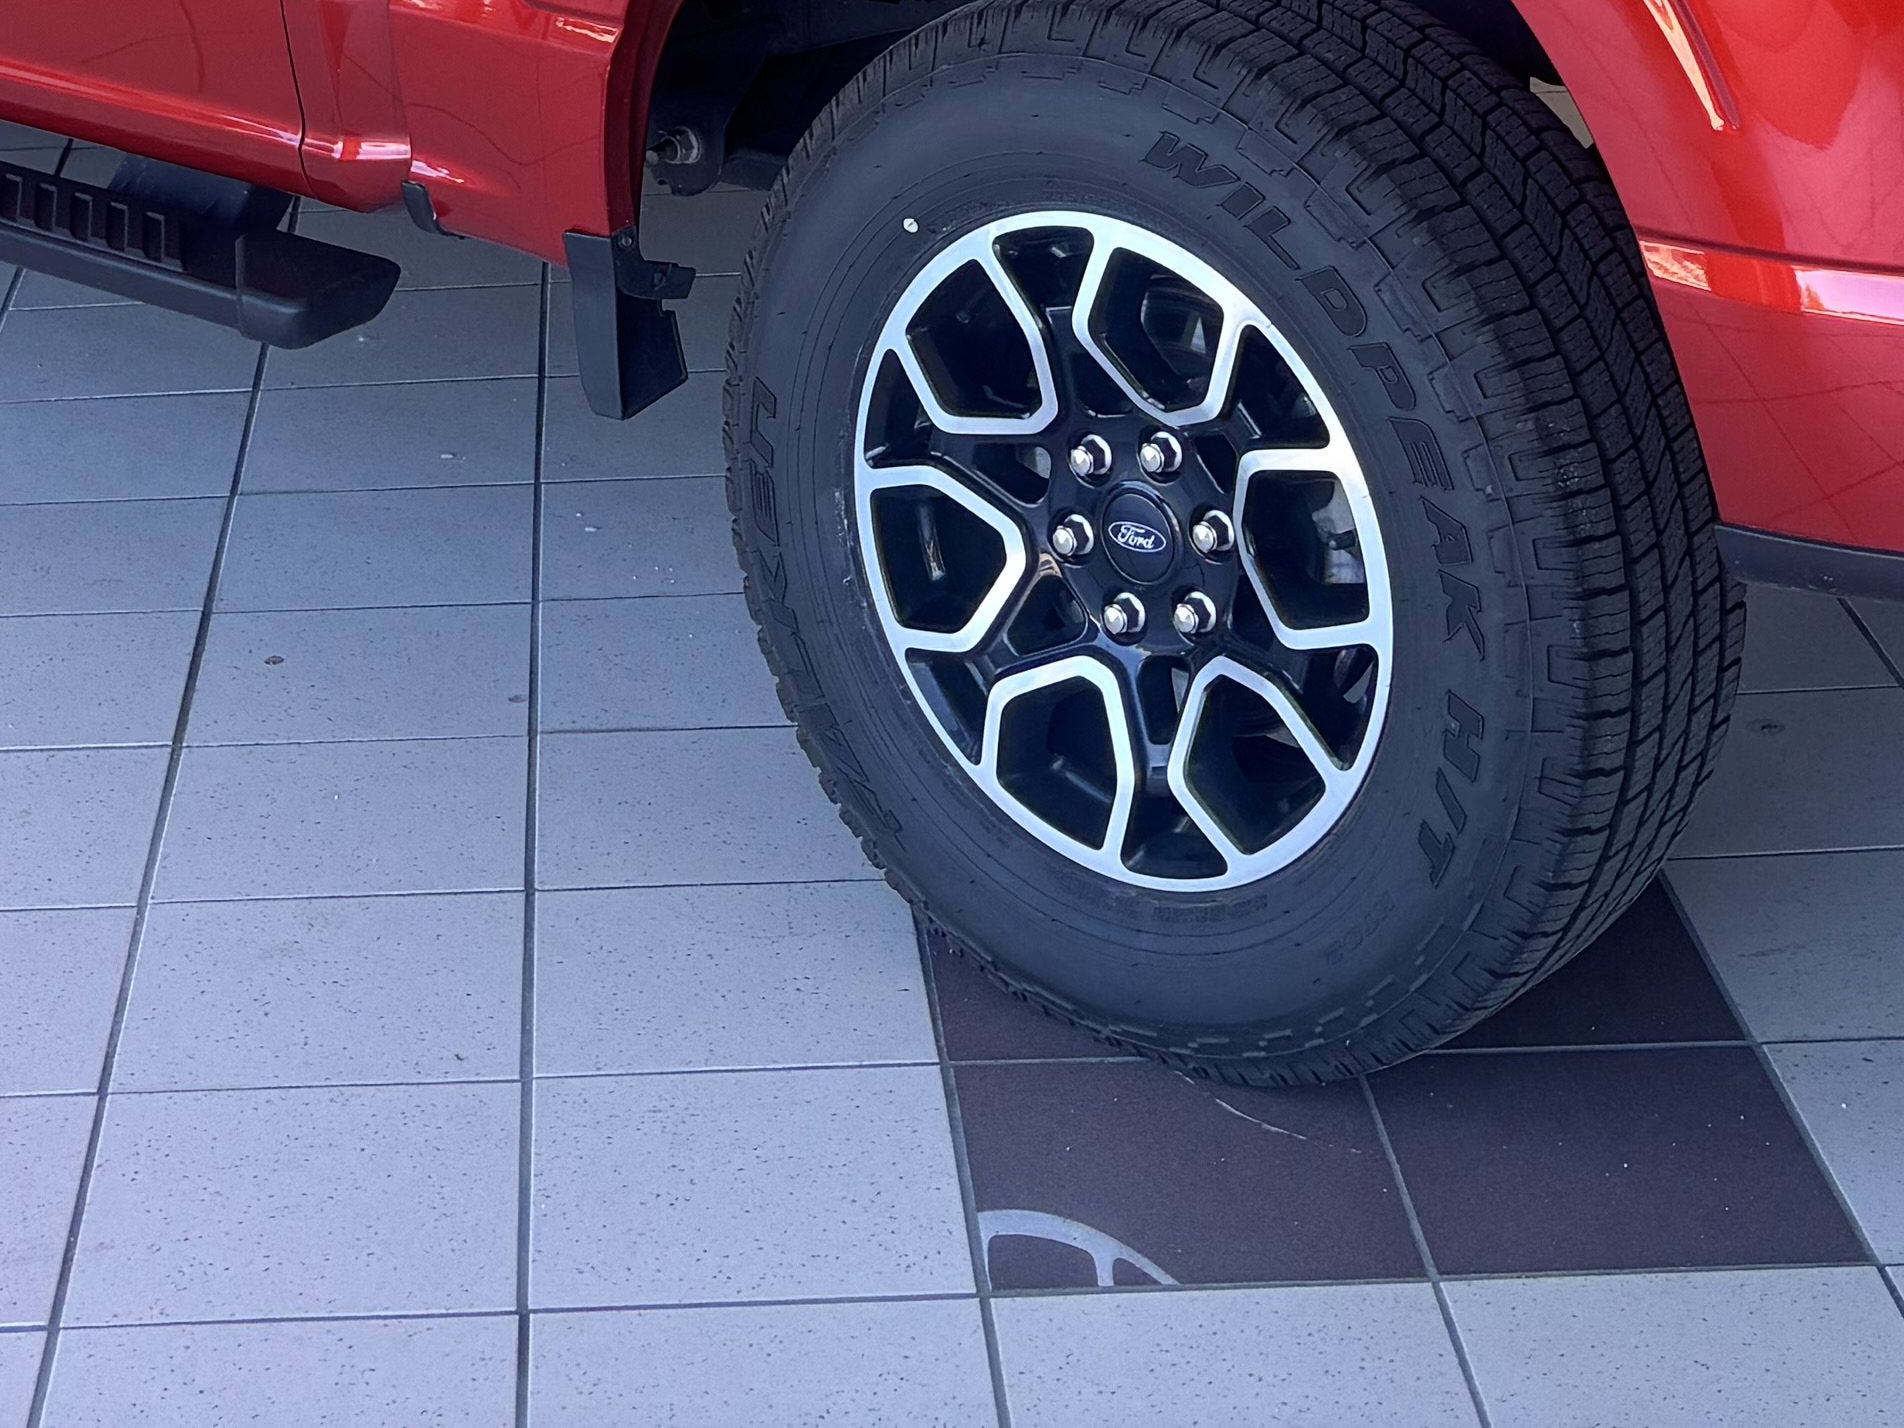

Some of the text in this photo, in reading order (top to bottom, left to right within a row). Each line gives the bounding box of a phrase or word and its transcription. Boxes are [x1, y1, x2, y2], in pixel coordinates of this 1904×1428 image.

[1117, 524, 1156, 550] Ford
[1140, 130, 1486, 661] WILDPEAK
[1416, 689, 1485, 889] H/T
